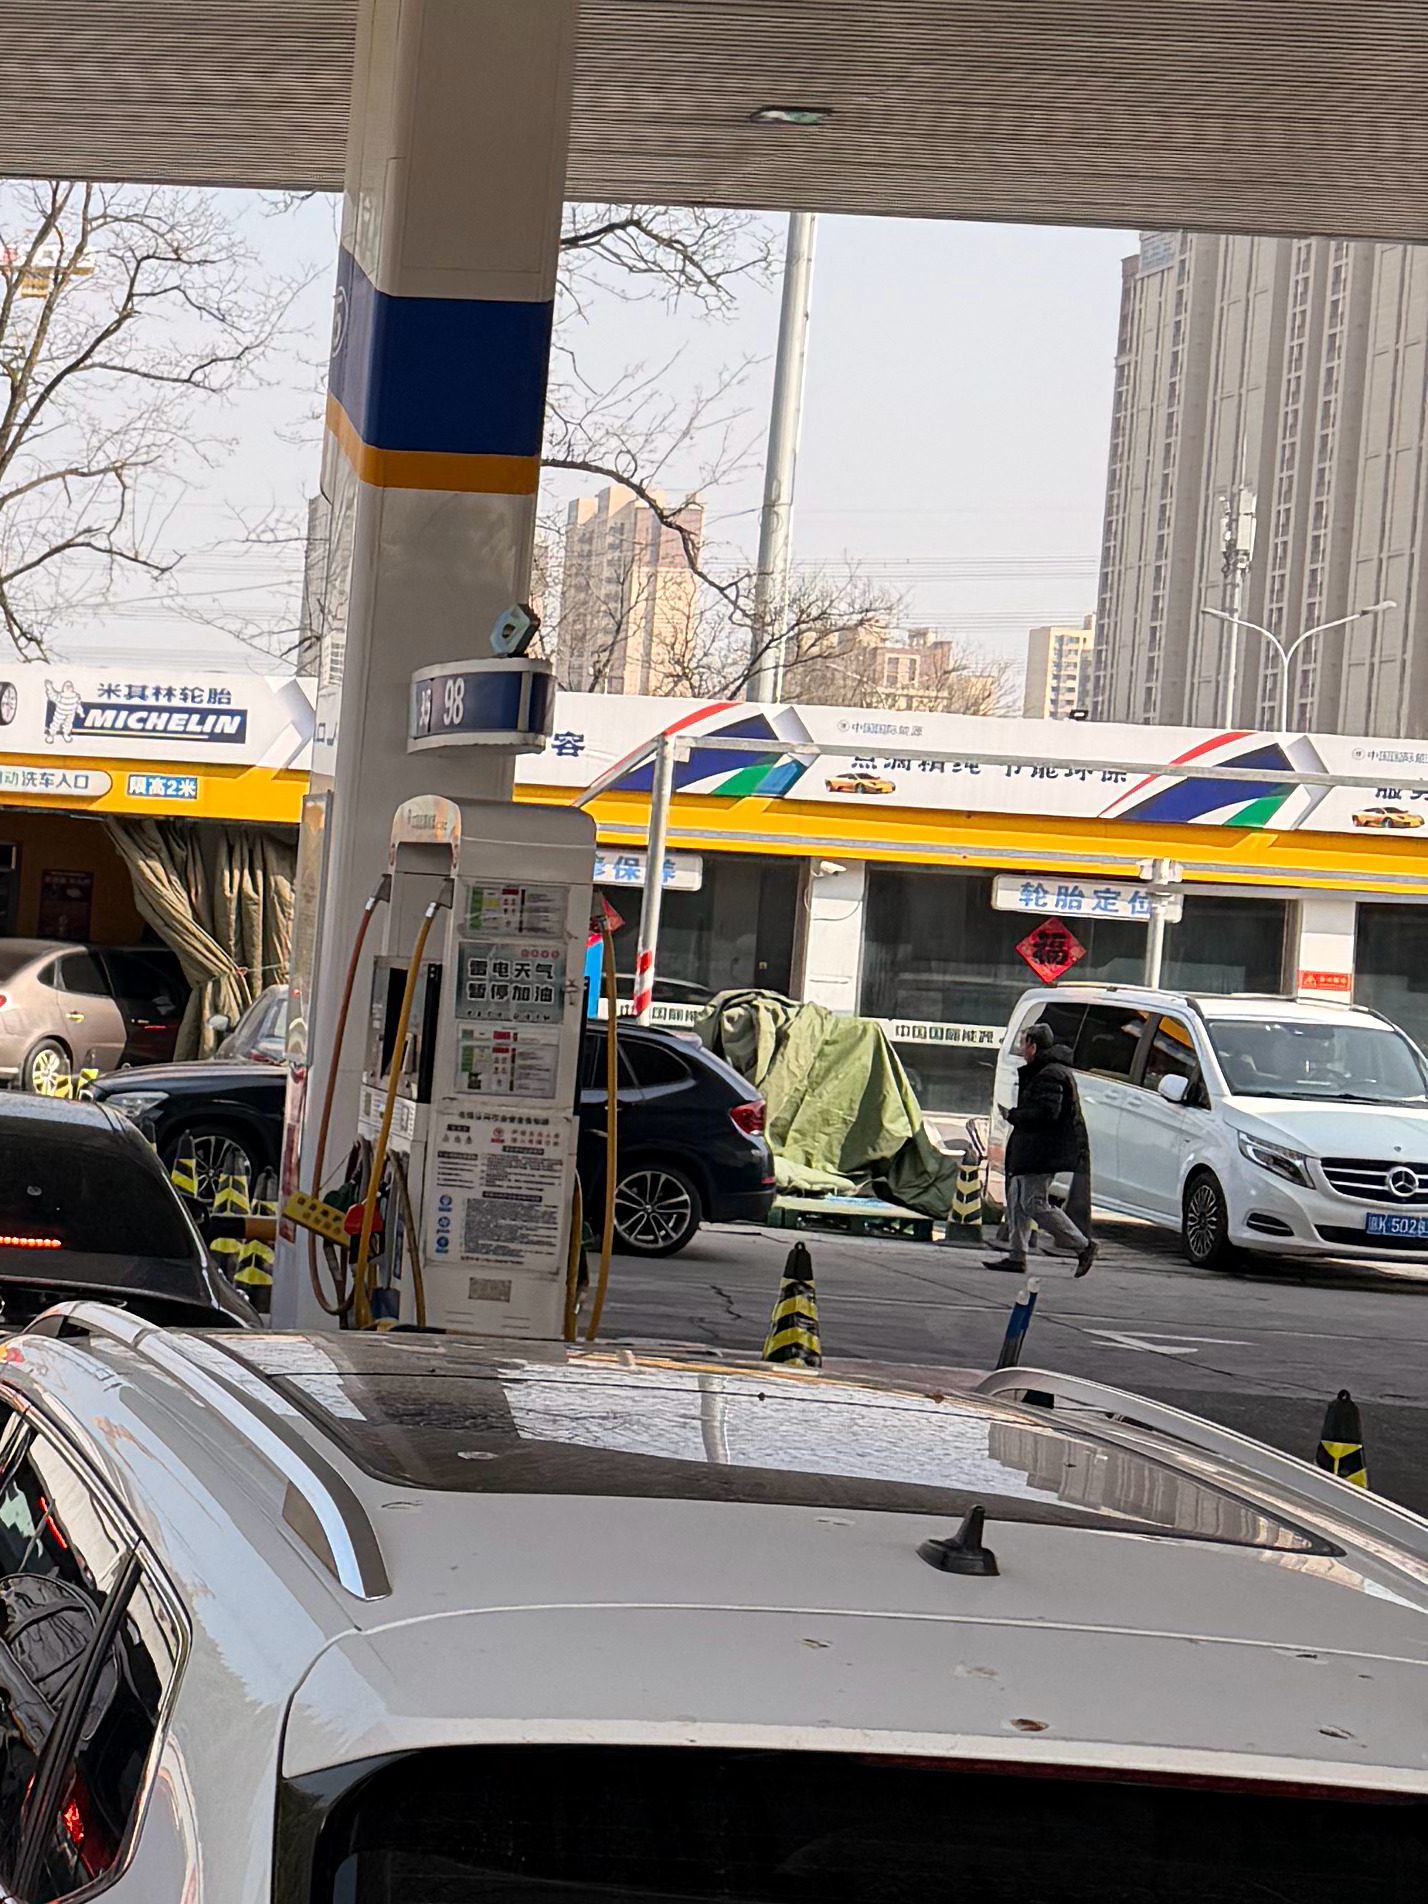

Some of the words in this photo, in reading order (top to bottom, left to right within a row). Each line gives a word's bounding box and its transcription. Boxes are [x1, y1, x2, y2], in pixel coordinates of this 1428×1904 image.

[97, 682, 233, 707] 米其林轮胎
[443, 676, 465, 726] 98
[84, 706, 242, 736] MICHELIN
[551, 731, 586, 757] 容
[127, 774, 198, 798] 限高2米
[468, 958, 555, 980] 雷电天气
[467, 982, 554, 1003] 暂停加油
